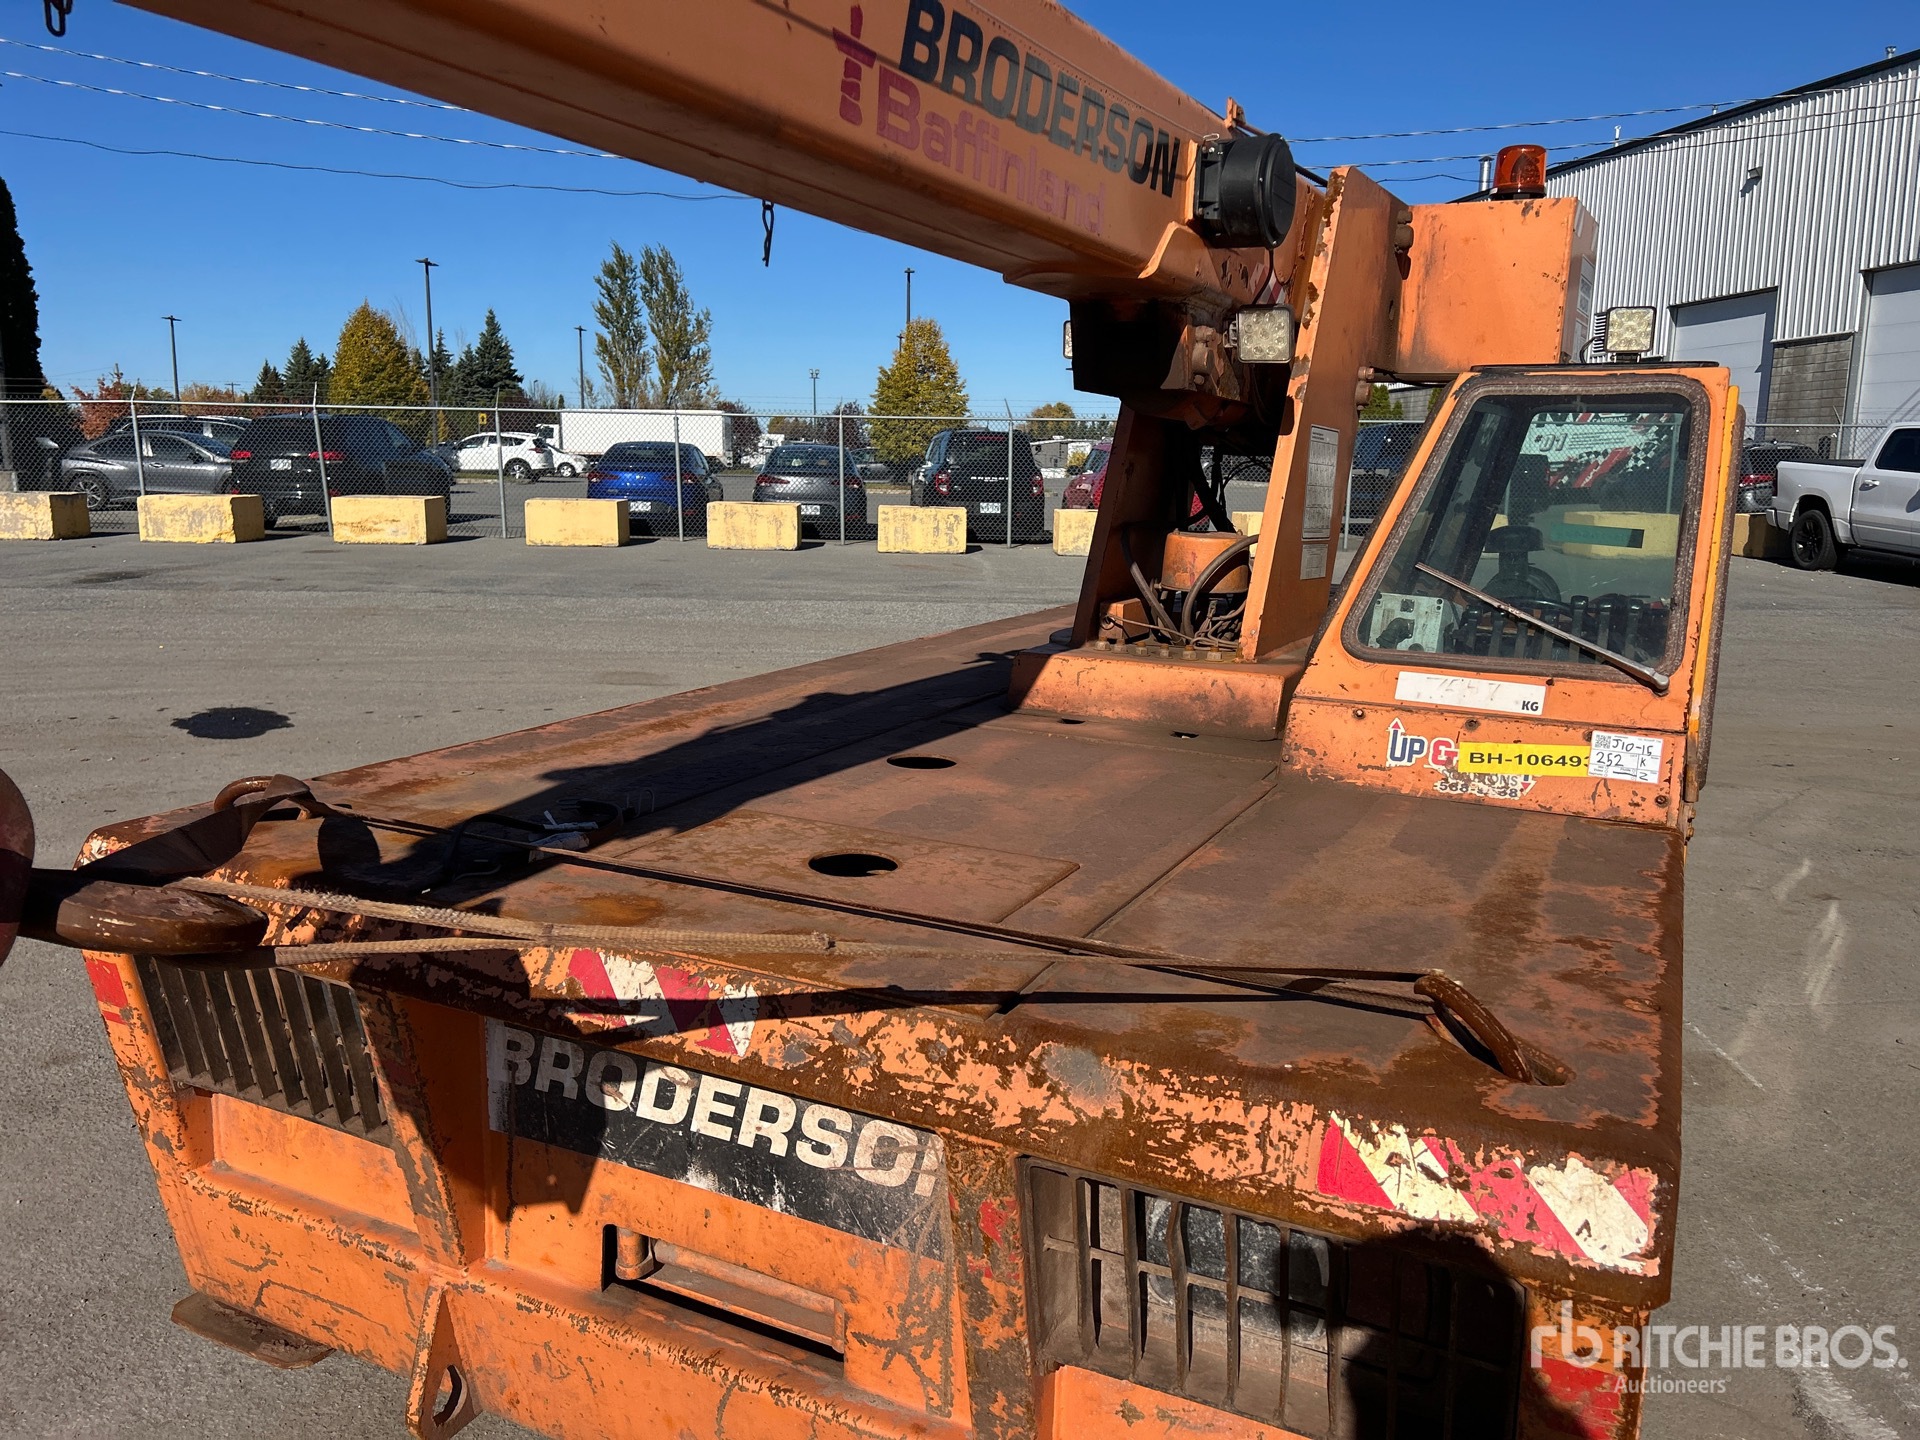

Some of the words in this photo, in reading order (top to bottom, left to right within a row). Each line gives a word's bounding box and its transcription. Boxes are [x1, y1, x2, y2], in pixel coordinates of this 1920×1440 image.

[900, 0, 1181, 198] BRODERSON
[876, 64, 1106, 237] Baffinland
[1521, 700, 1539, 712] KG
[1390, 726, 1426, 763] UP
[1596, 751, 1624, 767] 252
[1639, 757, 1647, 768] K
